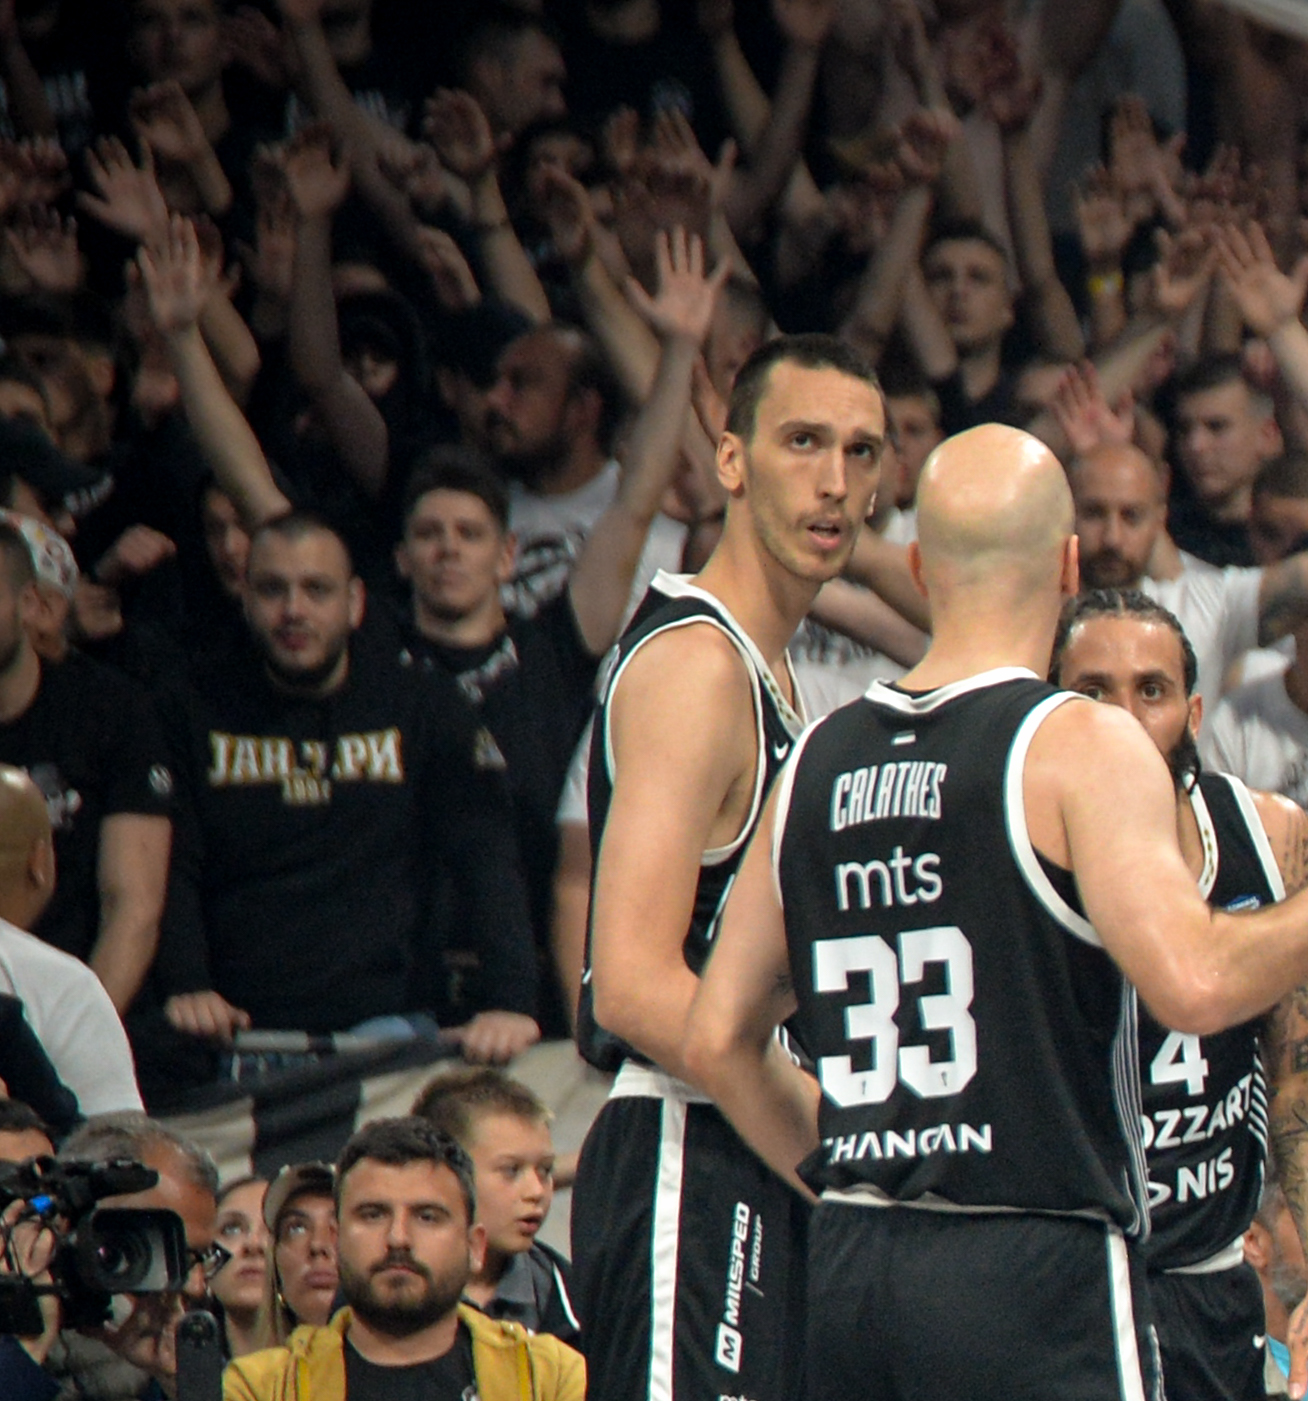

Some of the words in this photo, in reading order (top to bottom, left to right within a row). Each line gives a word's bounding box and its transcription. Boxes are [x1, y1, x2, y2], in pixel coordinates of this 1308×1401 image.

[830, 760, 947, 832] CALATHES
[835, 845, 943, 911] mts
[812, 925, 978, 1108] 33
[1150, 1031, 1209, 1096] 4
[823, 1123, 992, 1165] HANGAN
[1177, 1146, 1234, 1202] NIS
[724, 1201, 750, 1326] MILSPED
[749, 1213, 763, 1283] GROUP
